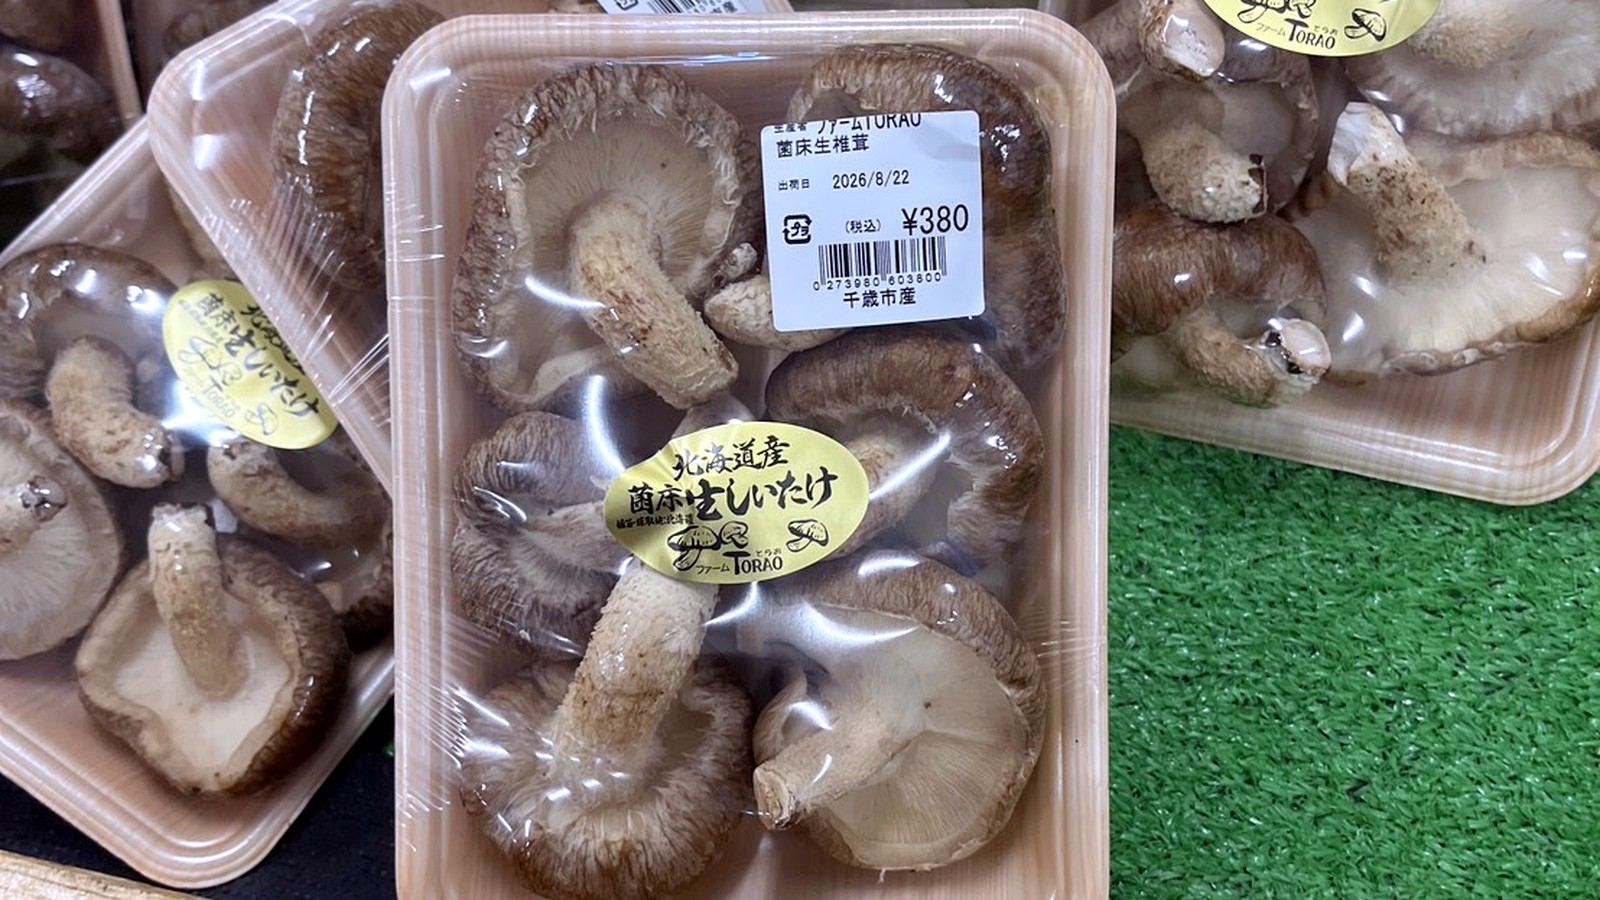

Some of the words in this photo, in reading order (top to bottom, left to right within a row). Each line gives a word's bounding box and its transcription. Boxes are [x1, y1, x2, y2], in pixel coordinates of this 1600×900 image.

[1284, 18, 1336, 49] TORAO
[776, 133, 869, 158] 菌床生椎茸
[778, 178, 810, 191] 出荷日
[832, 170, 910, 189] 2026/8/22
[901, 204, 969, 236] ¥380
[827, 277, 880, 290] 273980
[888, 272, 941, 285] 603800
[843, 287, 917, 309] 千歳市産
[672, 435, 792, 481] 北海道産
[628, 466, 838, 521] 菌床生しいたけ
[695, 562, 730, 575] ファーム
[722, 551, 783, 575] TORAO
